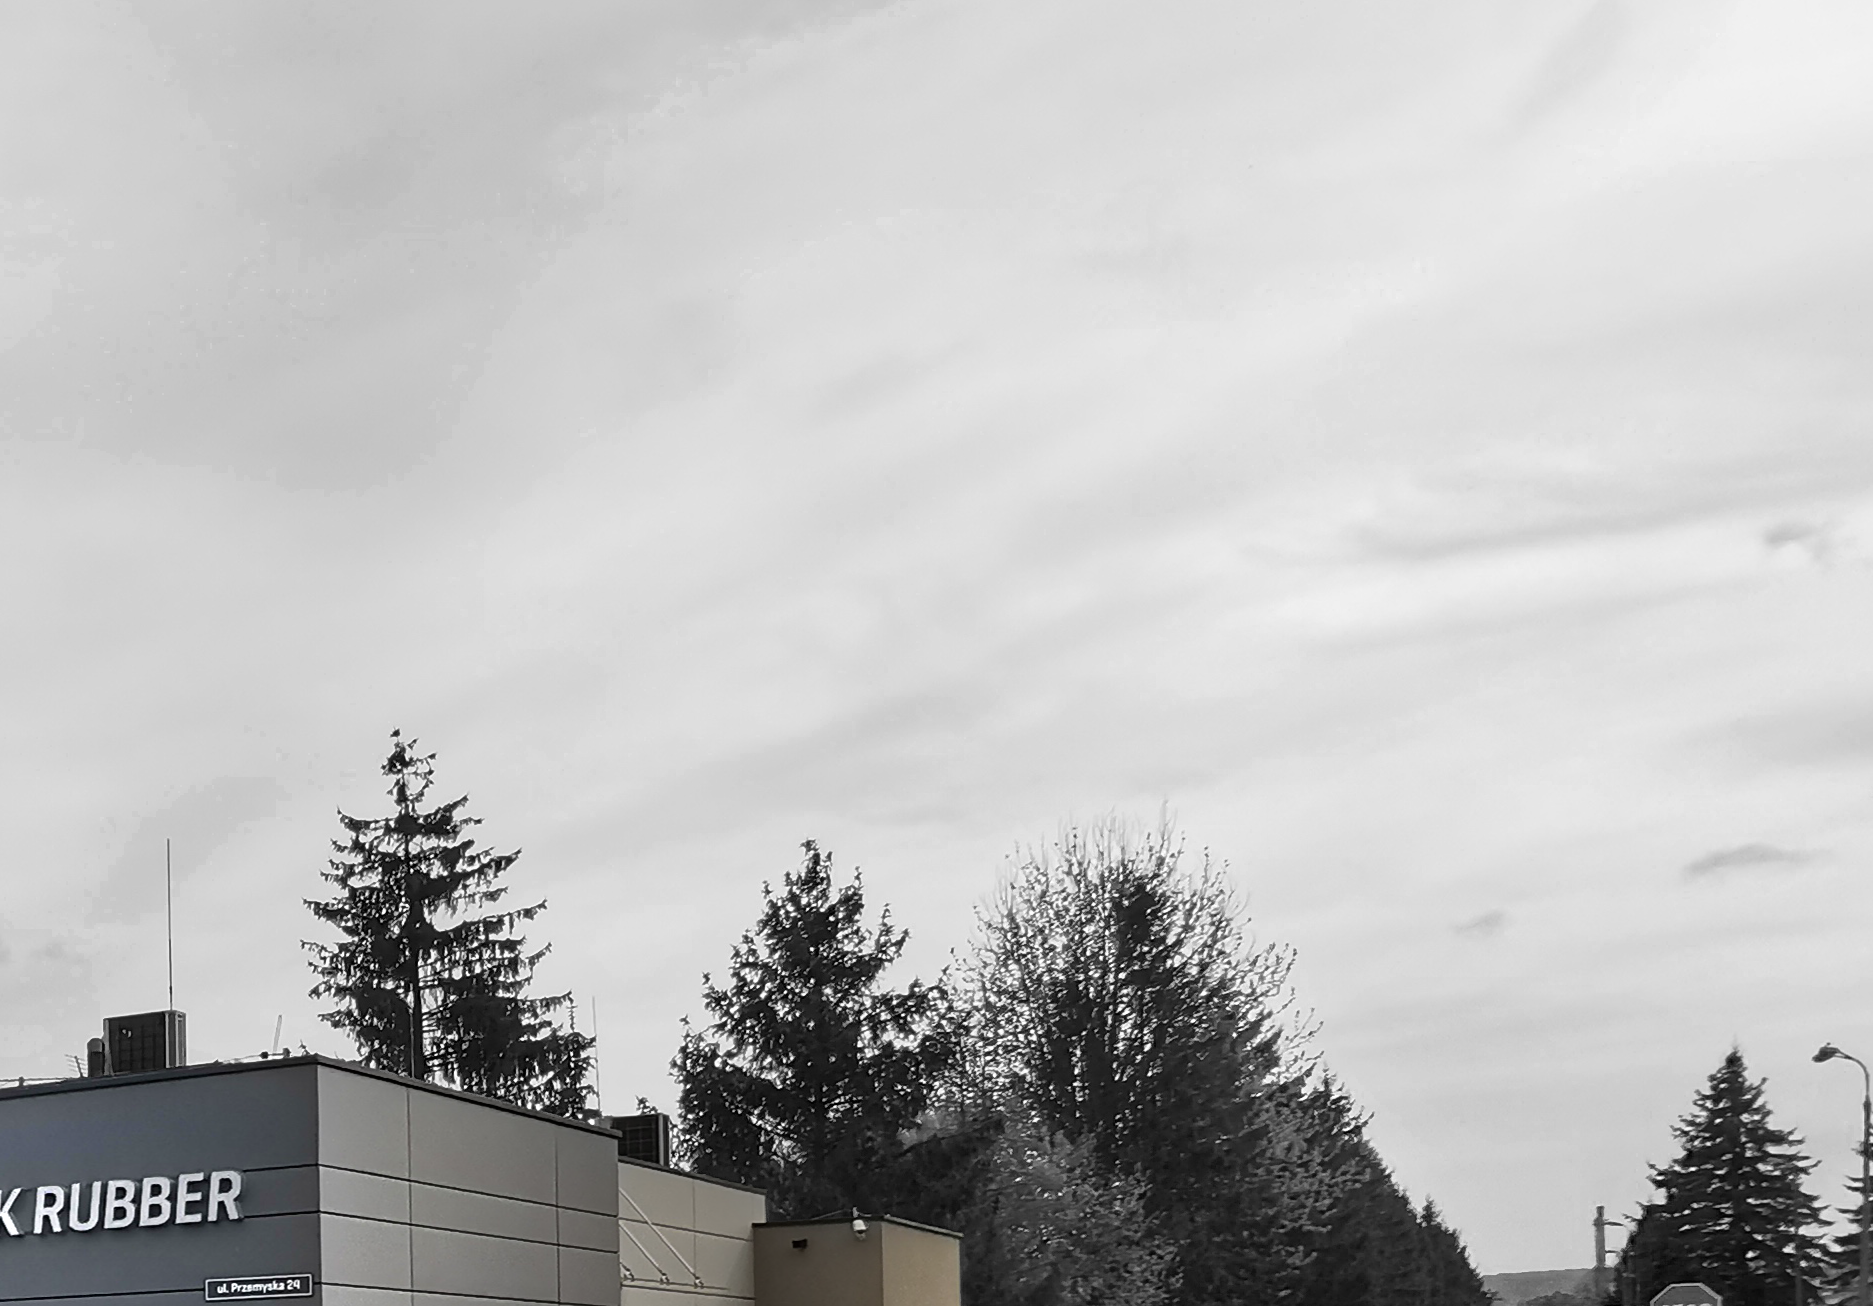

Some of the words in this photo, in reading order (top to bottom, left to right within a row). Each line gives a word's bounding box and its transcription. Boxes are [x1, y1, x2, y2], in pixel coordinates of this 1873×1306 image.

[33, 1170, 243, 1235] RUBBER
[217, 1283, 229, 1293] ul.
[231, 1281, 285, 1293] Przemyska
